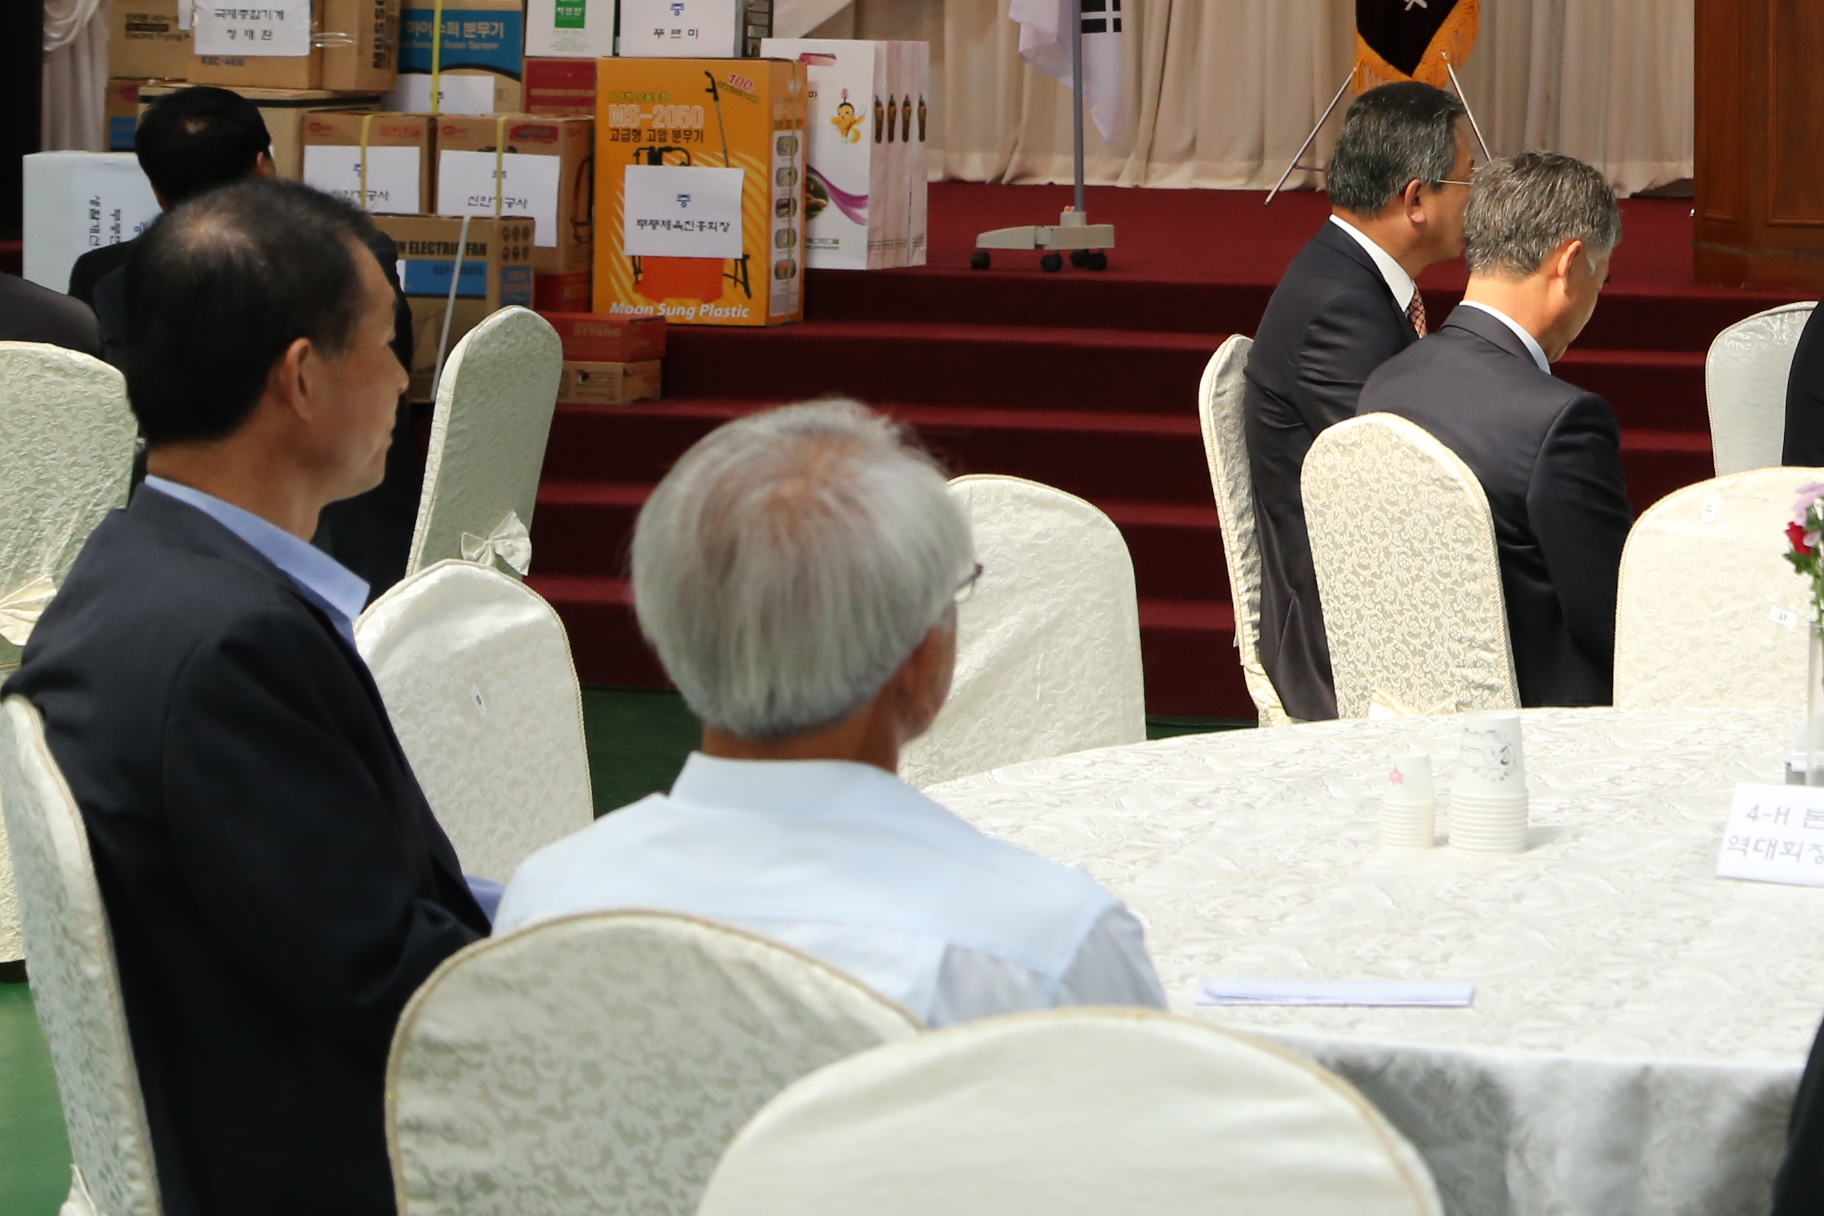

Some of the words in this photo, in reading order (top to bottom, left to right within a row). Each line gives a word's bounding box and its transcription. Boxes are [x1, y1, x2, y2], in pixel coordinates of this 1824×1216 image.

[608, 104, 705, 130] MS-2050
[671, 129, 705, 144] 분무기
[656, 302, 697, 320] Sung
[699, 302, 751, 319] Plastic
[1745, 803, 1790, 828] 4-H
